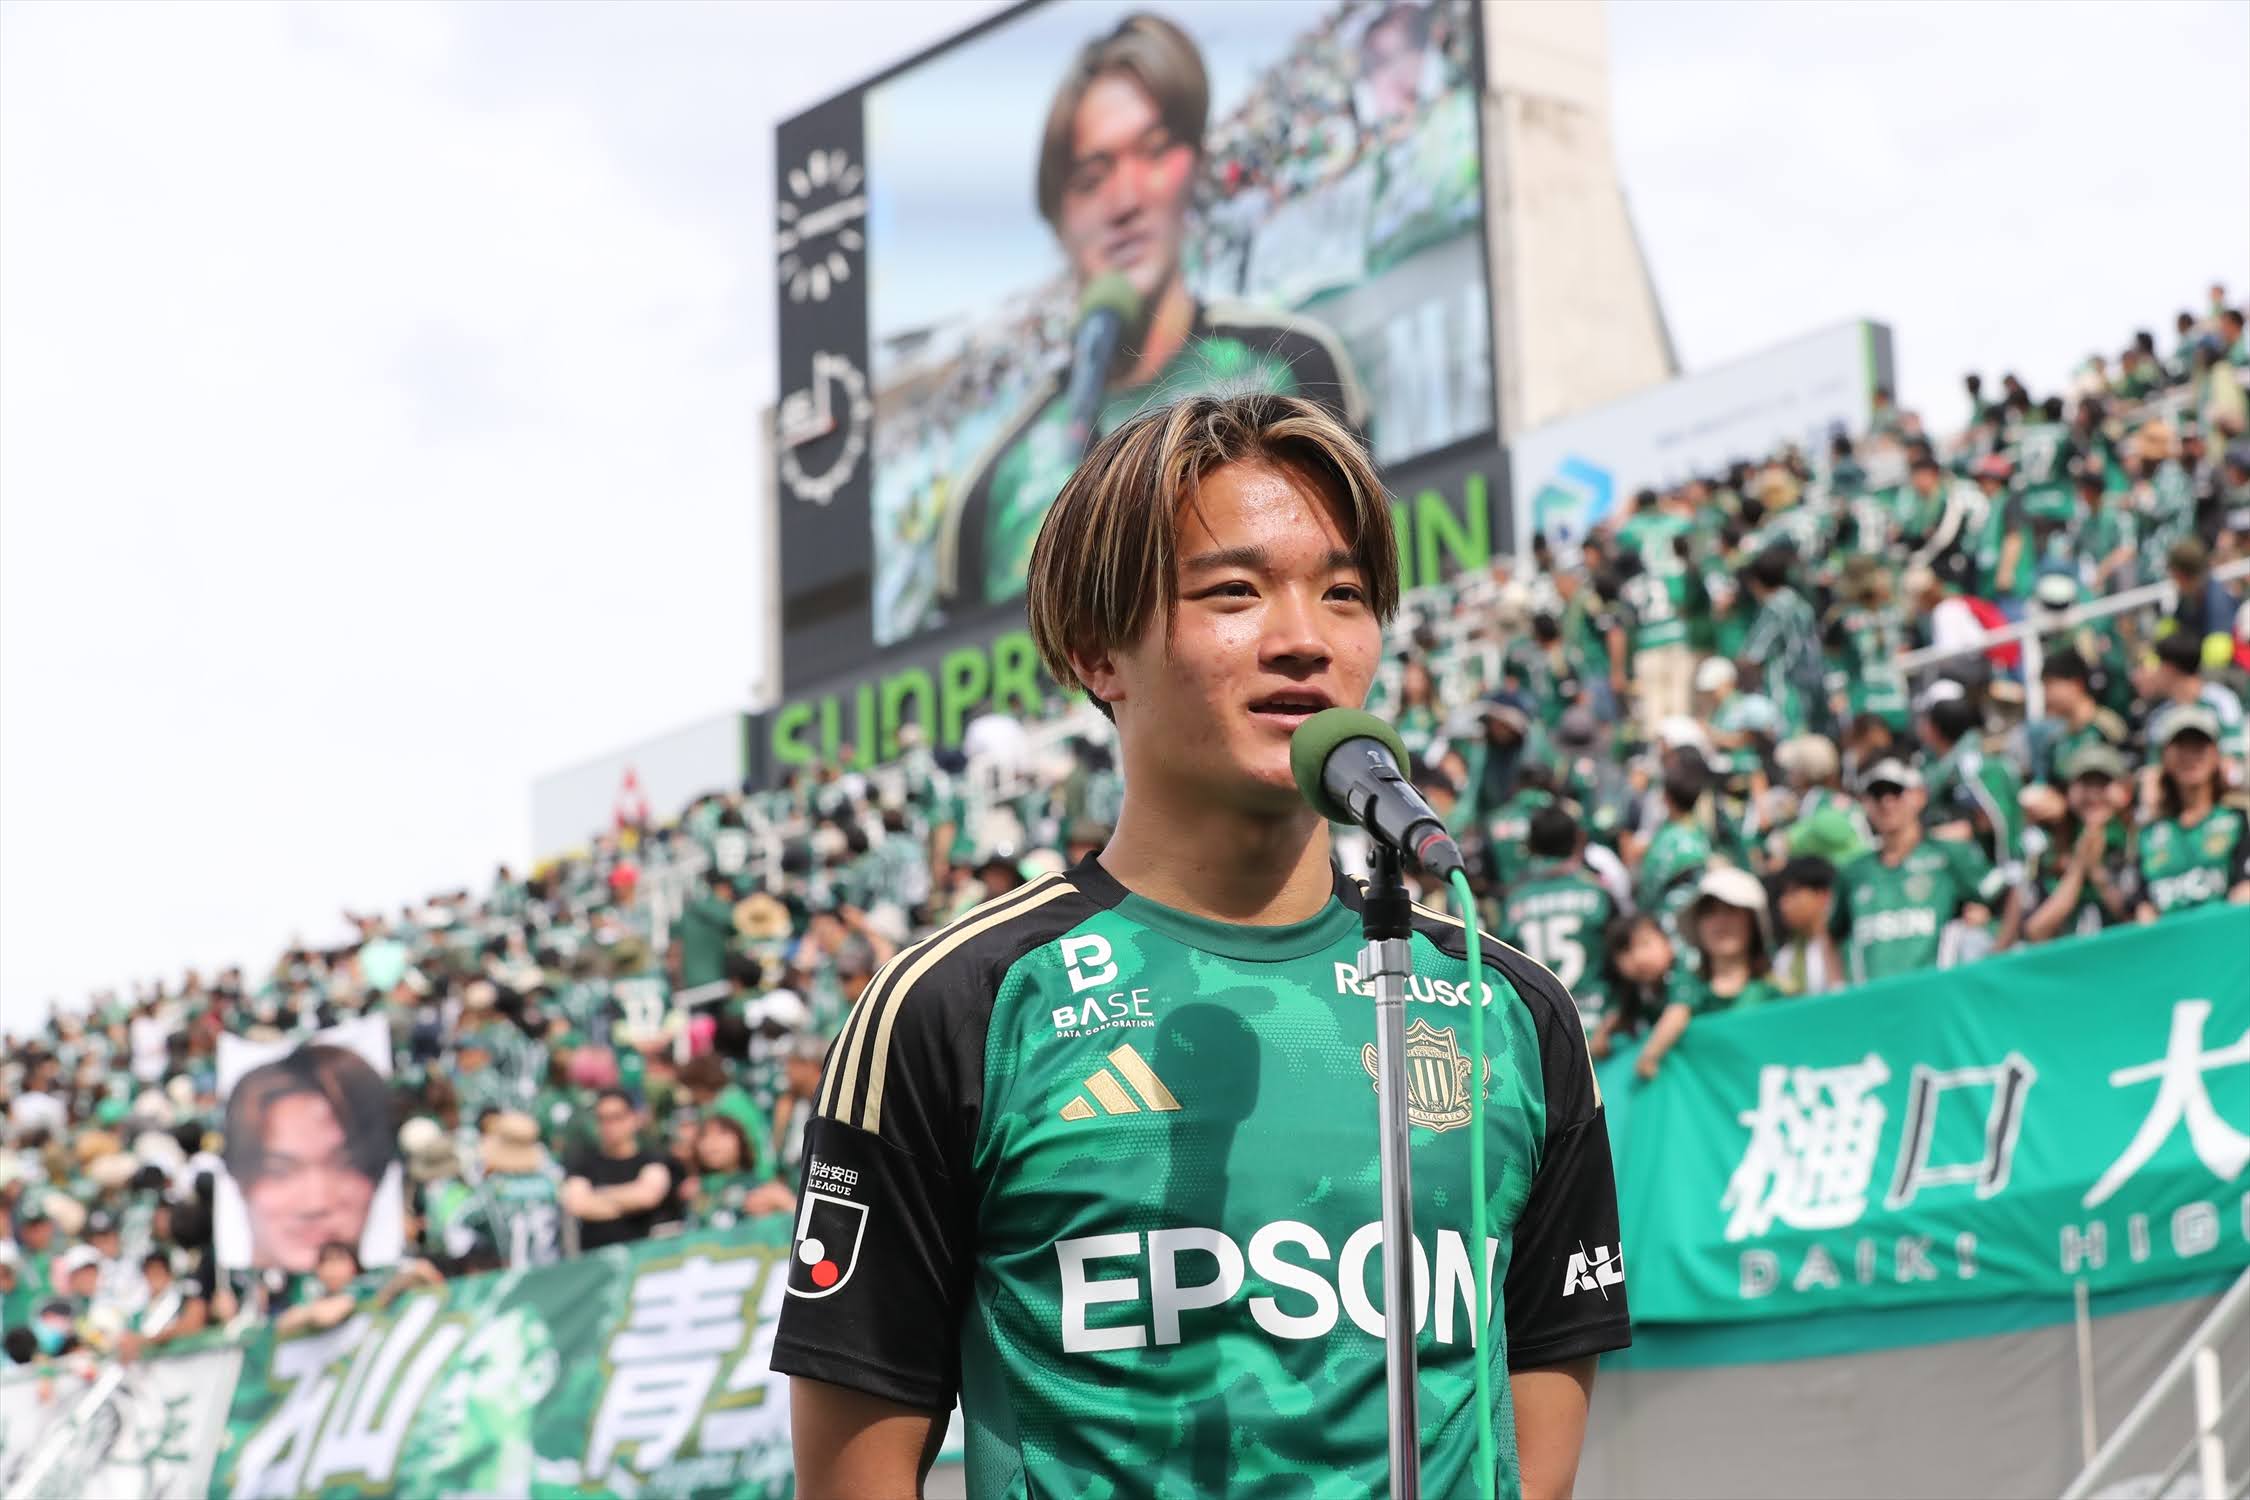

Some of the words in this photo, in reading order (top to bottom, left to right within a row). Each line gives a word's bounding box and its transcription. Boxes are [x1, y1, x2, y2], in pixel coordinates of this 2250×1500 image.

[1052, 988, 1153, 1029] BASE
[1056, 1029, 1081, 1038] DATA
[1085, 1019, 1155, 1037] CORPORATION
[2059, 1190, 2250, 1274] HIG
[1054, 1220, 1498, 1353] EPSON
